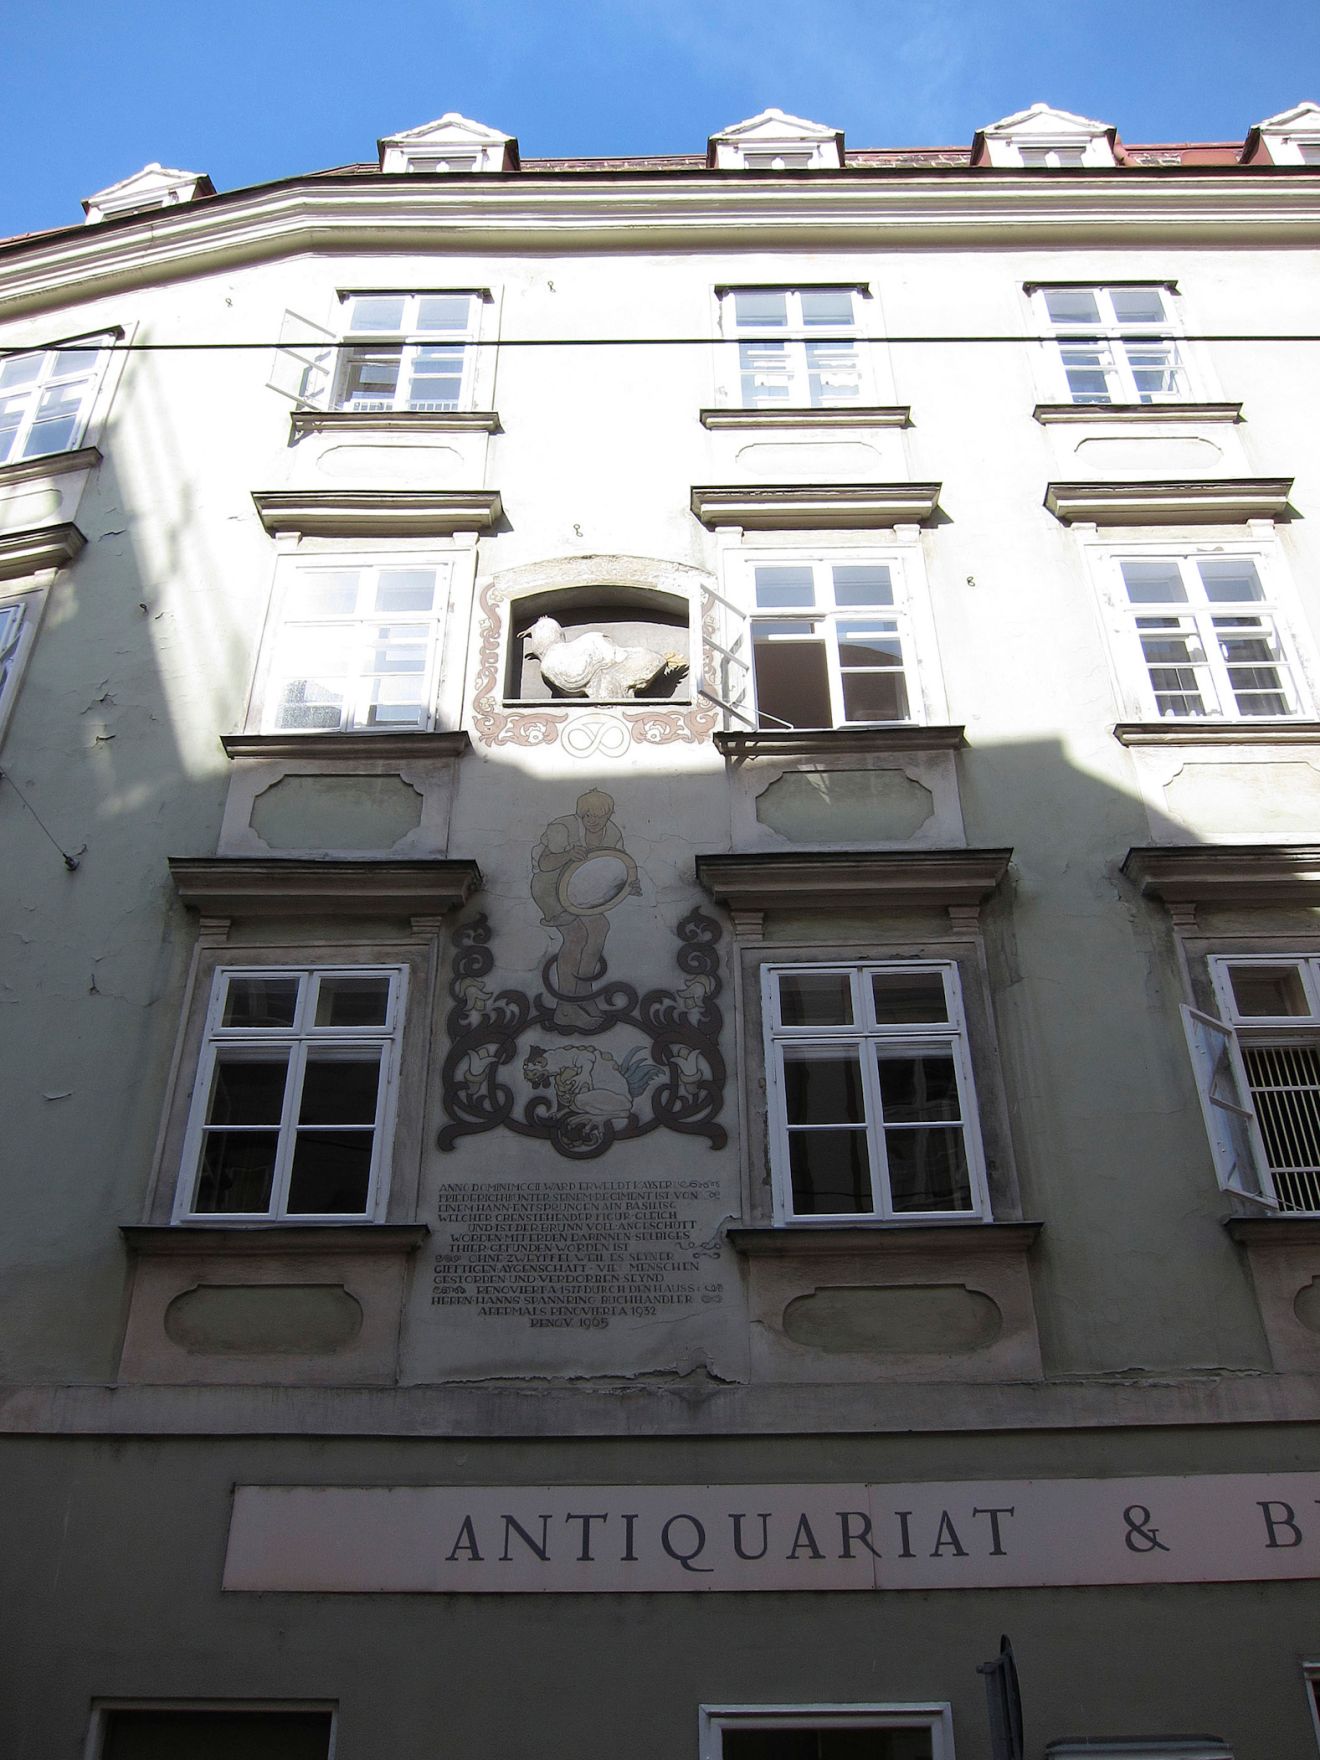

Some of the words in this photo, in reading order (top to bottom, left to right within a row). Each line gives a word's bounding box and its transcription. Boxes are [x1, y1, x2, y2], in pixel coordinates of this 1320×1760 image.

[439, 1183, 469, 1192] ANNO
[472, 1183, 510, 1192] DOMINI
[445, 1506, 1015, 1572] ANTIQUARIAT
[1122, 1504, 1171, 1553] &
[1256, 1500, 1320, 1548] B
